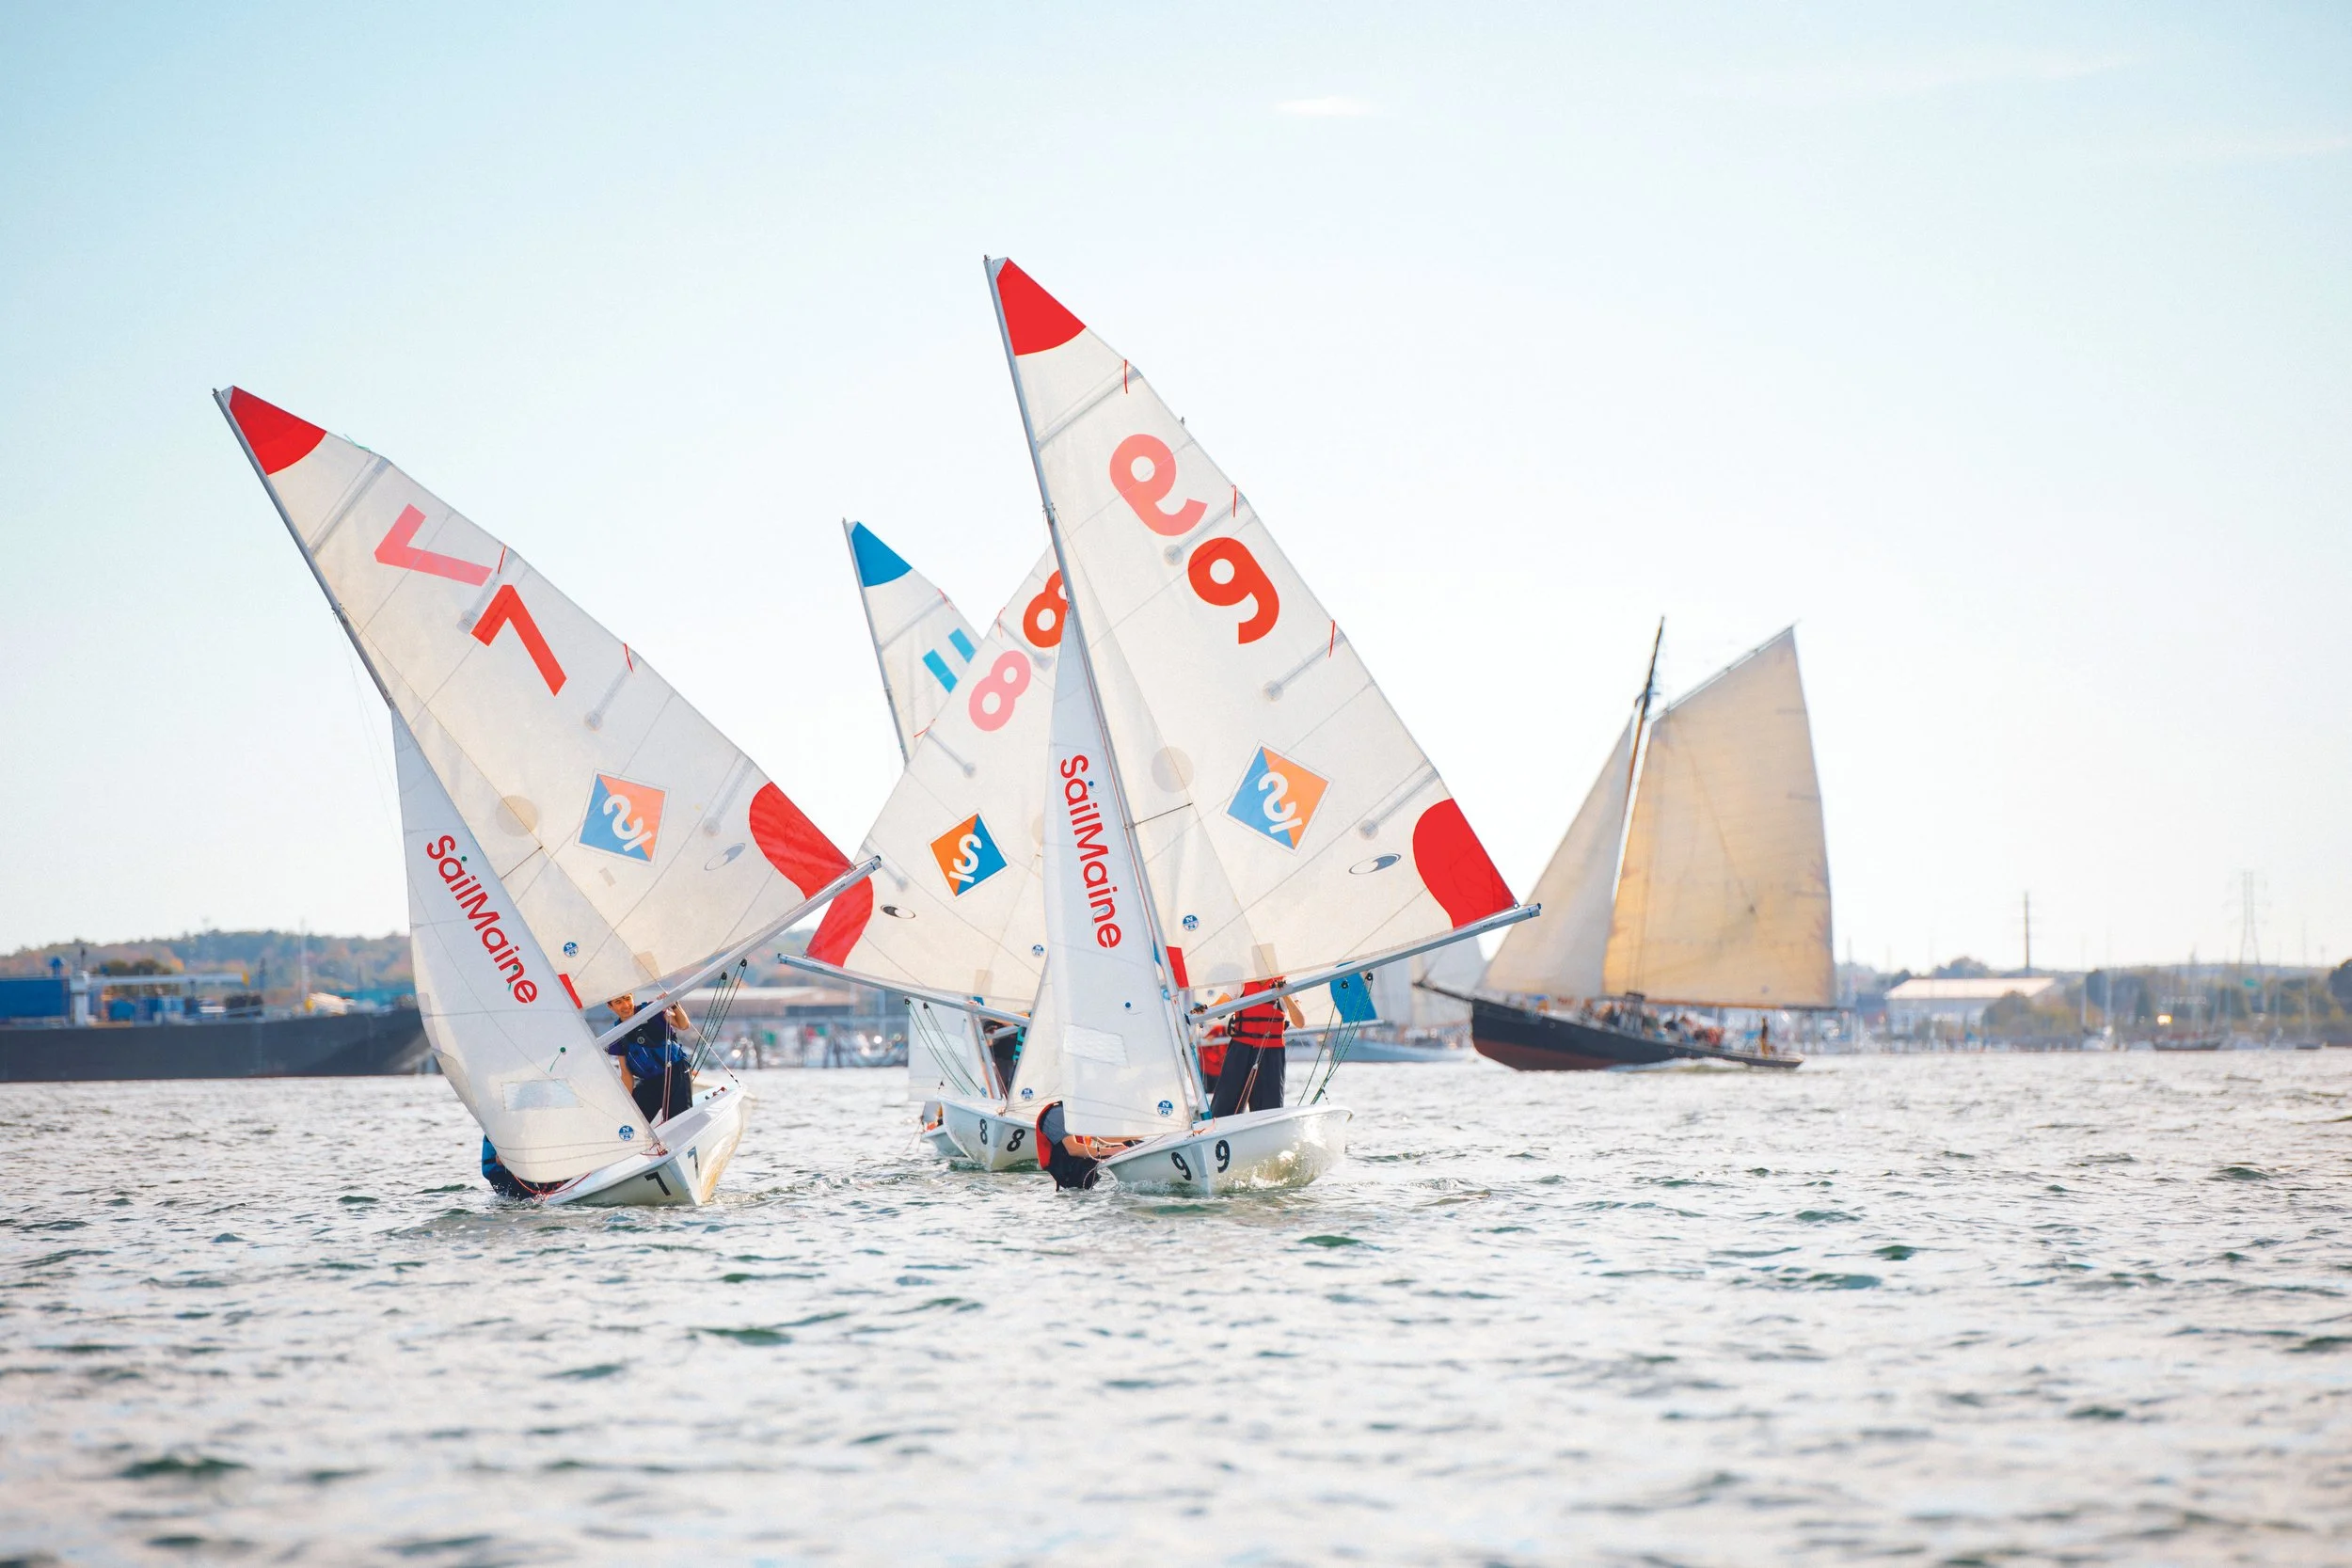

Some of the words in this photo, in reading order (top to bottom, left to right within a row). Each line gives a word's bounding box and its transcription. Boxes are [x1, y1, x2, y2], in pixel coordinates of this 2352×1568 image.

[1023, 568, 1070, 649] 8
[1187, 536, 1280, 645] 9
[469, 583, 567, 697] 7
[968, 650, 1032, 732] 8
[1059, 752, 1123, 950] SailMaine
[426, 833, 539, 1005] SailMaine
[979, 1118, 988, 1146] 8
[1006, 1128, 1026, 1153] 8
[1215, 1139, 1231, 1174] 9
[644, 1170, 672, 1196] 7
[687, 1146, 699, 1180] 7
[1170, 1151, 1193, 1181] 9
